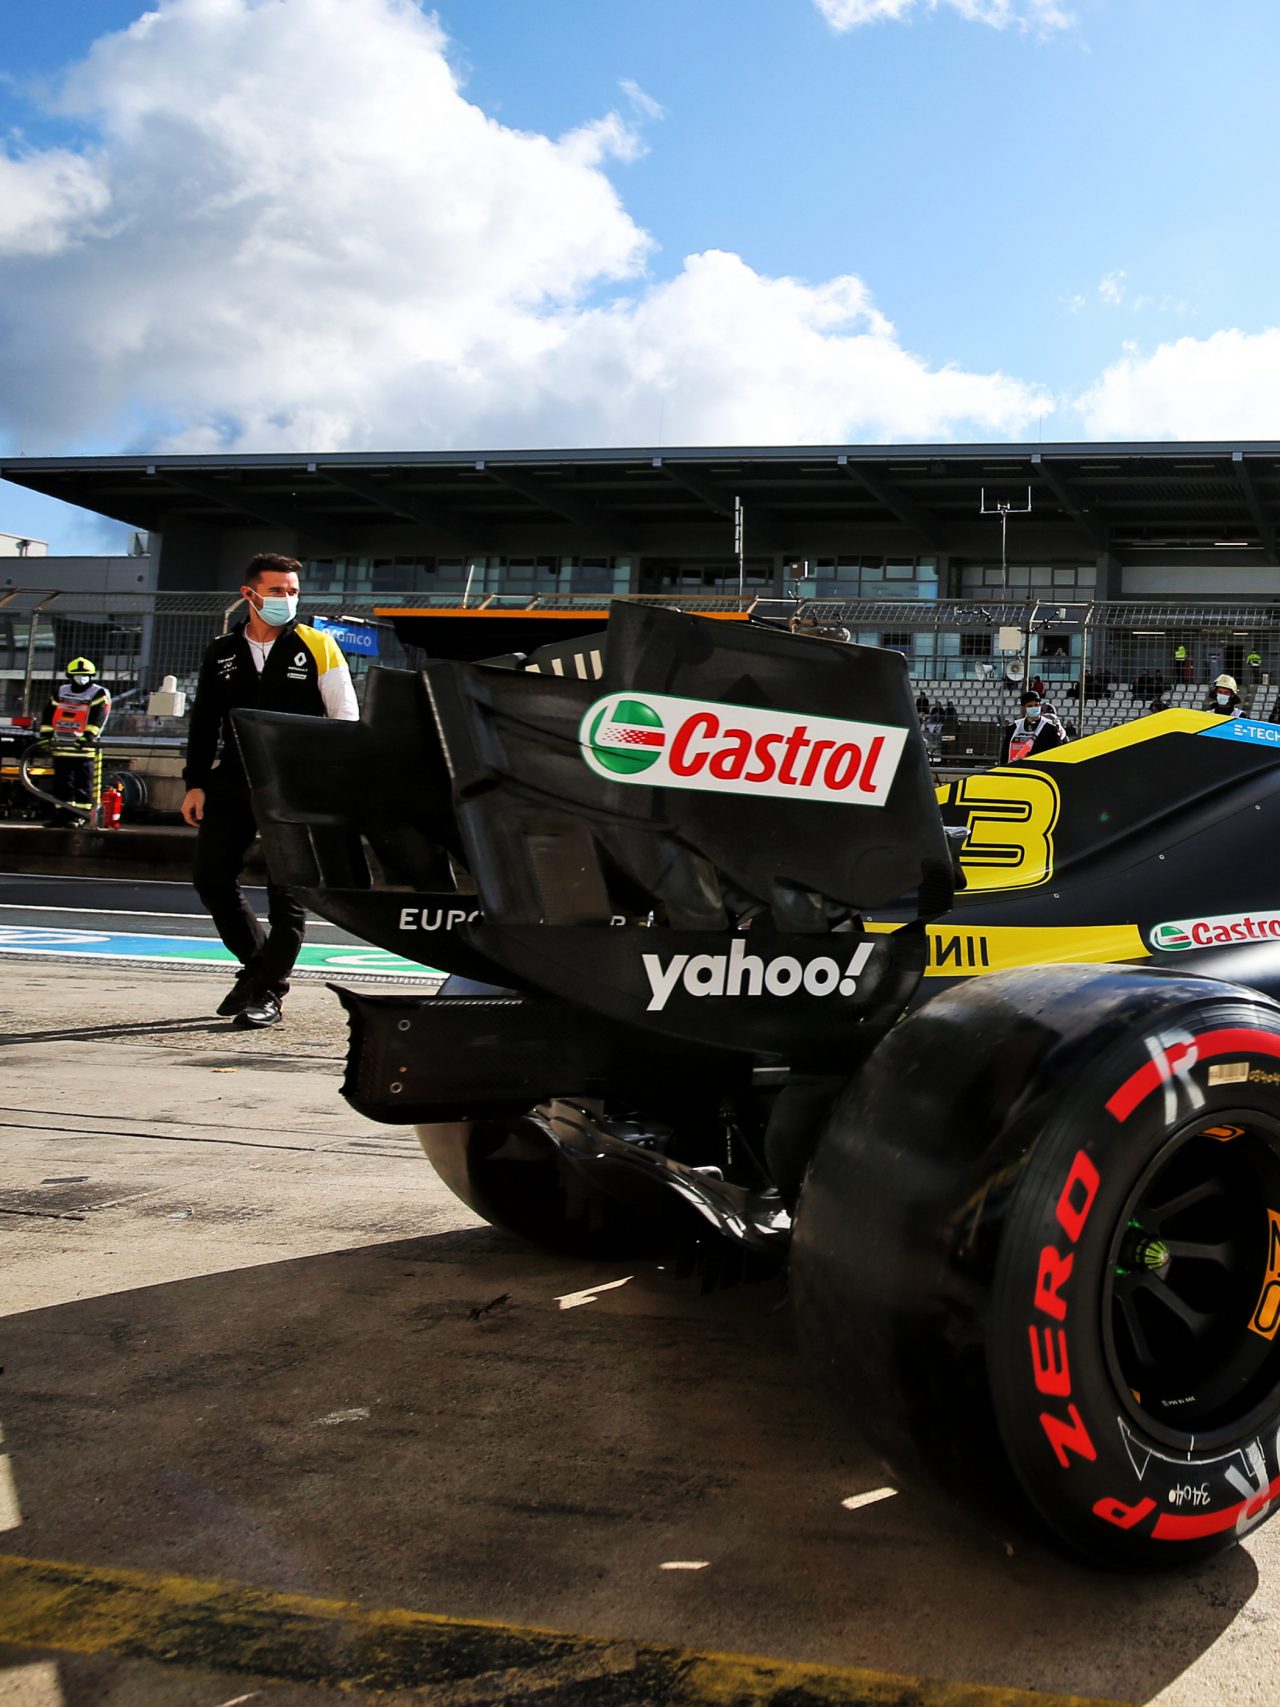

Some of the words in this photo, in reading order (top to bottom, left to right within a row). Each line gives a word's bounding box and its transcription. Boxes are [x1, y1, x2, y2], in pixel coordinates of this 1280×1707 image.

[668, 711, 886, 793] Castrol
[642, 938, 876, 1011] yahoo!
[1028, 1149, 1100, 1469] ZERO
